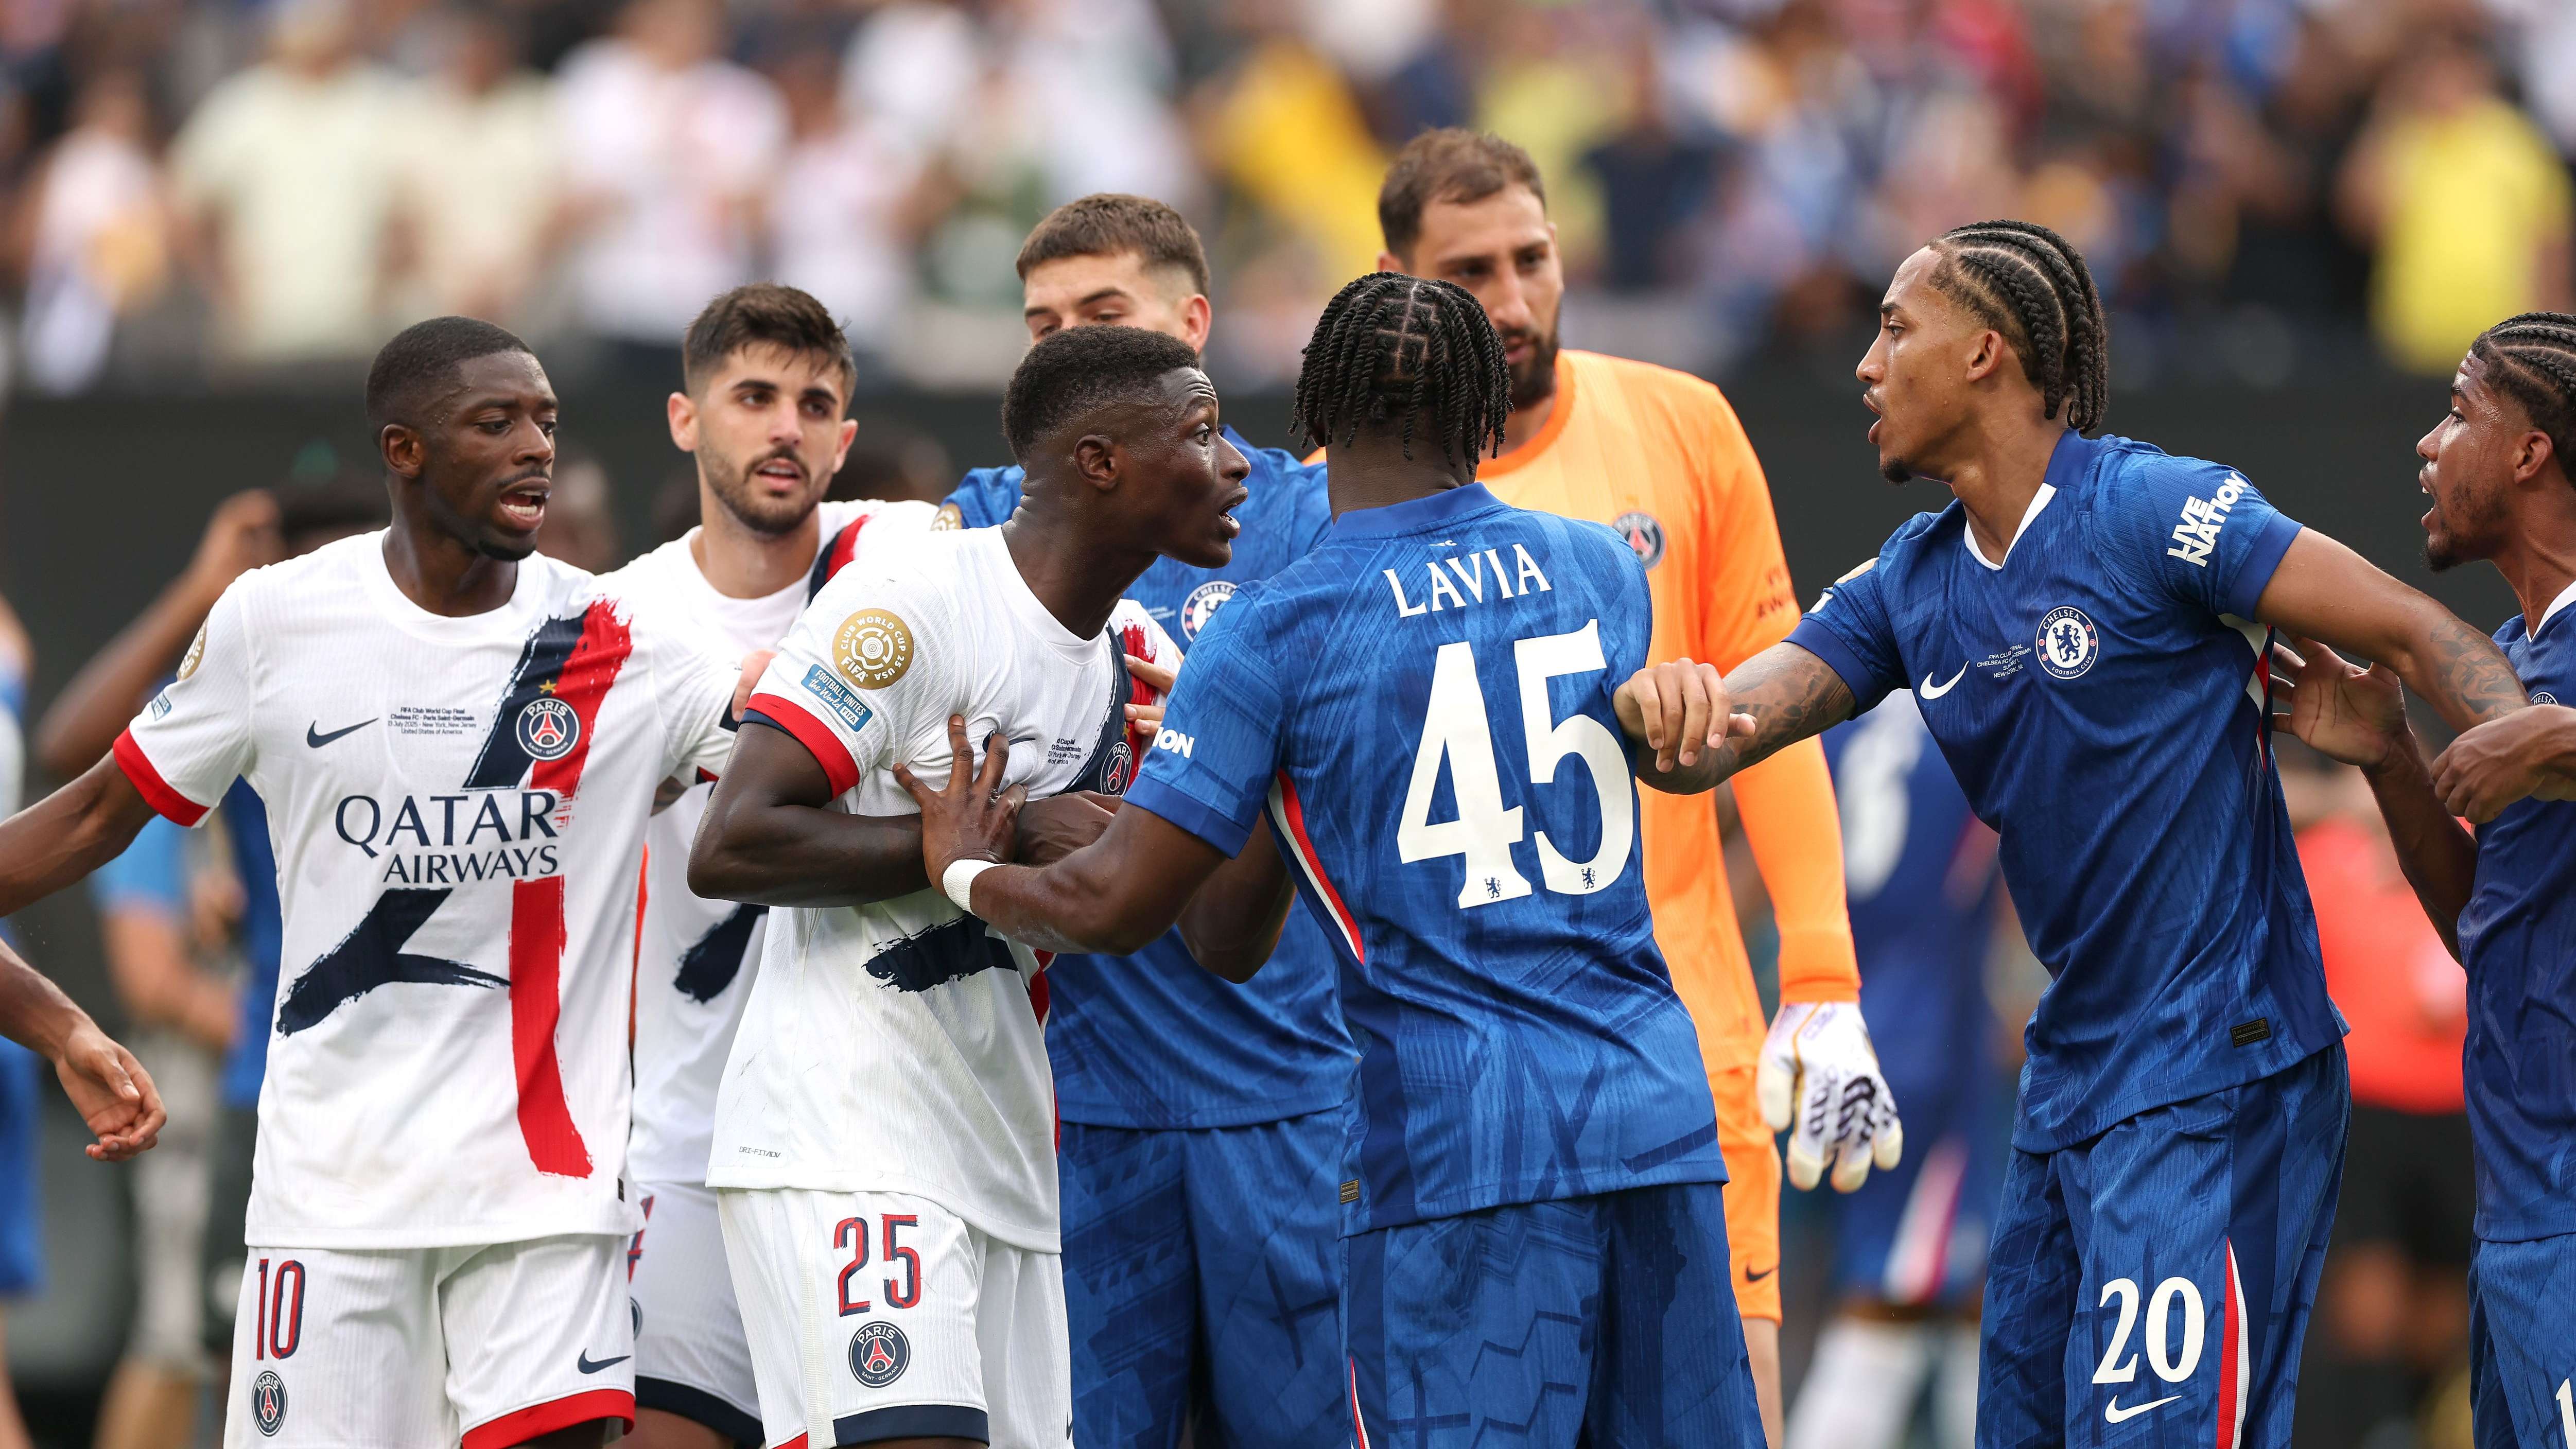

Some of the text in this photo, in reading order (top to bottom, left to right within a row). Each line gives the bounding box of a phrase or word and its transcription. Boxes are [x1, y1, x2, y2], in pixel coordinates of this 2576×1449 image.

[2167, 496, 2209, 560] LIVE
[2186, 471, 2248, 567] NATION
[1383, 543, 1552, 618] LAVIA
[2043, 609, 2079, 630] CHELSEA
[841, 616, 906, 680] CLUB WORLD CUP 25 USA
[2051, 656, 2092, 675] FOOTBALL CLUB
[841, 656, 866, 683] FIFA
[527, 701, 568, 717] PARIS
[808, 679, 844, 710] the World
[815, 669, 866, 716] FOOTBALL UNITES
[842, 708, 856, 723] FIFA
[1112, 745, 1131, 764] PARIS
[1152, 726, 1195, 759] ION
[1396, 619, 1633, 909] 45
[336, 792, 558, 858] QATAR
[383, 845, 558, 883] AIRWAYS
[833, 1213, 921, 1317] 25
[256, 1258, 306, 1360] 10
[857, 1326, 896, 1345] PARIS
[2092, 1276, 2205, 1384] 20
[257, 1375, 279, 1391] PARIS
[861, 1371, 875, 1381] SAINT
[878, 1365, 899, 1381] GERMAIN
